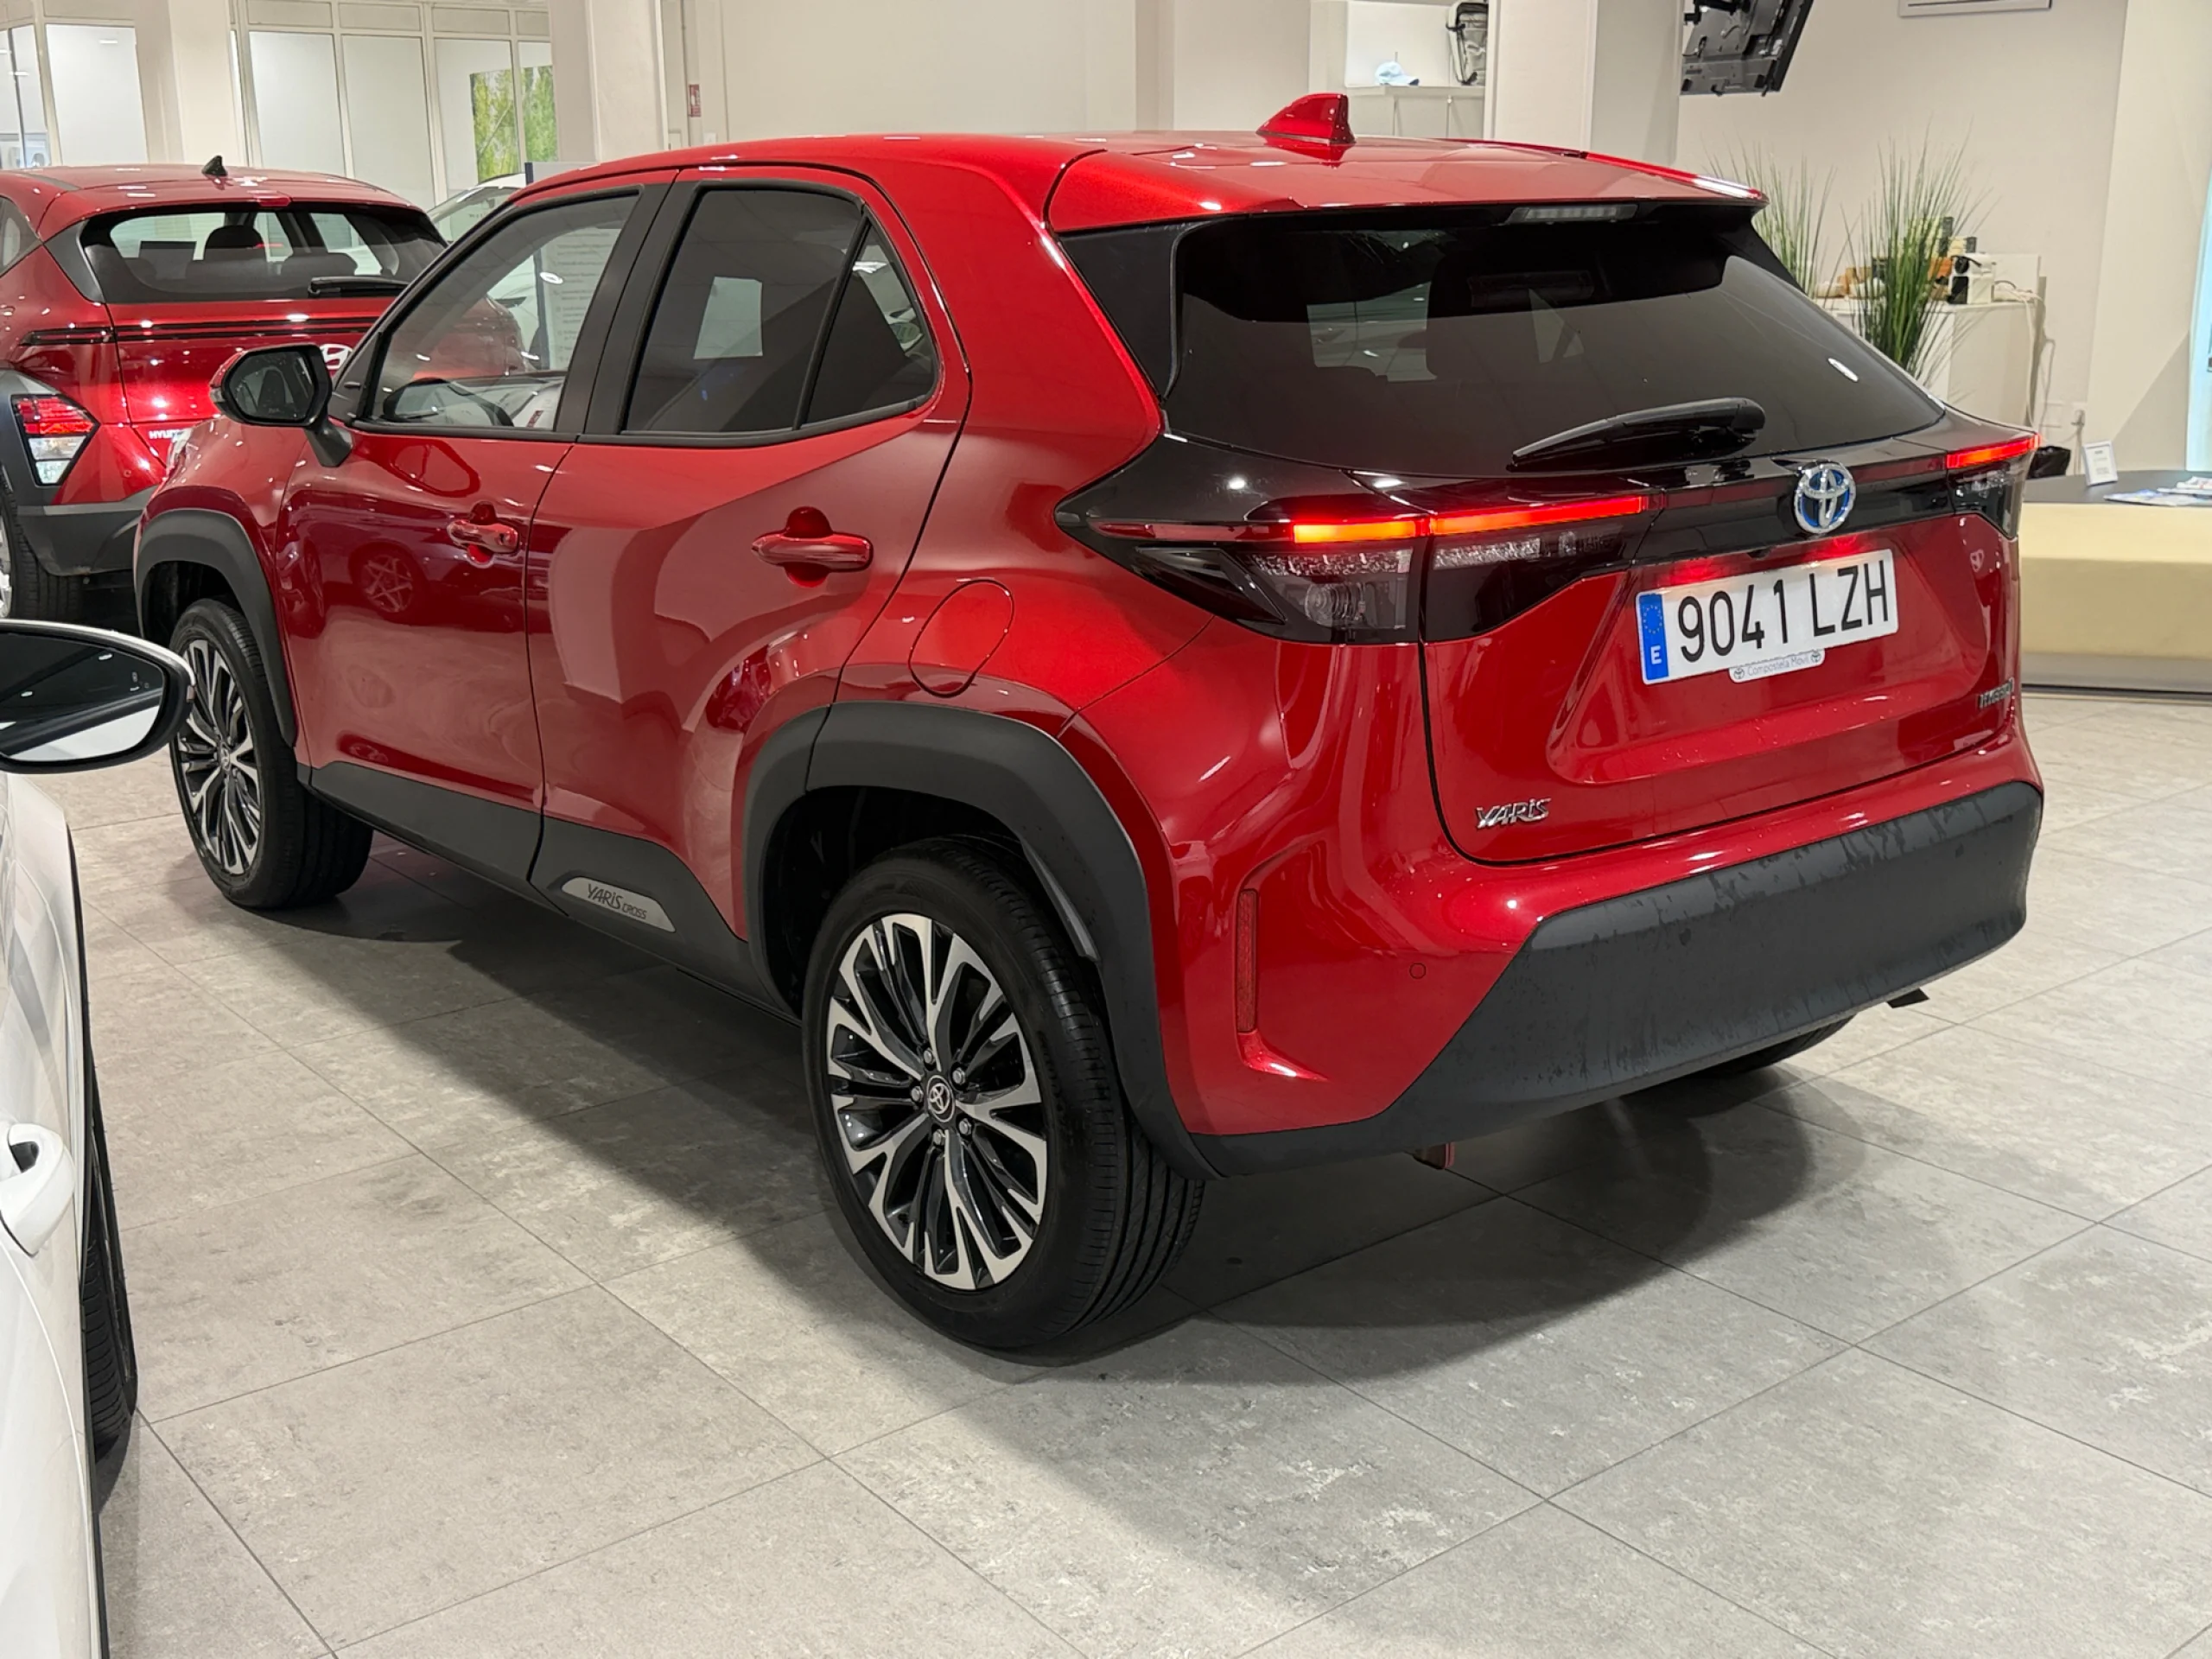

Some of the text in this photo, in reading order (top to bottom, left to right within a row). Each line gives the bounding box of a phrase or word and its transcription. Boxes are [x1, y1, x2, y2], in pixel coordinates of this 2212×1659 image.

[1677, 560, 1889, 663] 9041 LZH
[1650, 645, 1662, 664] E
[1747, 660, 1789, 677] Compostela
[622, 903, 647, 919] CROSS
